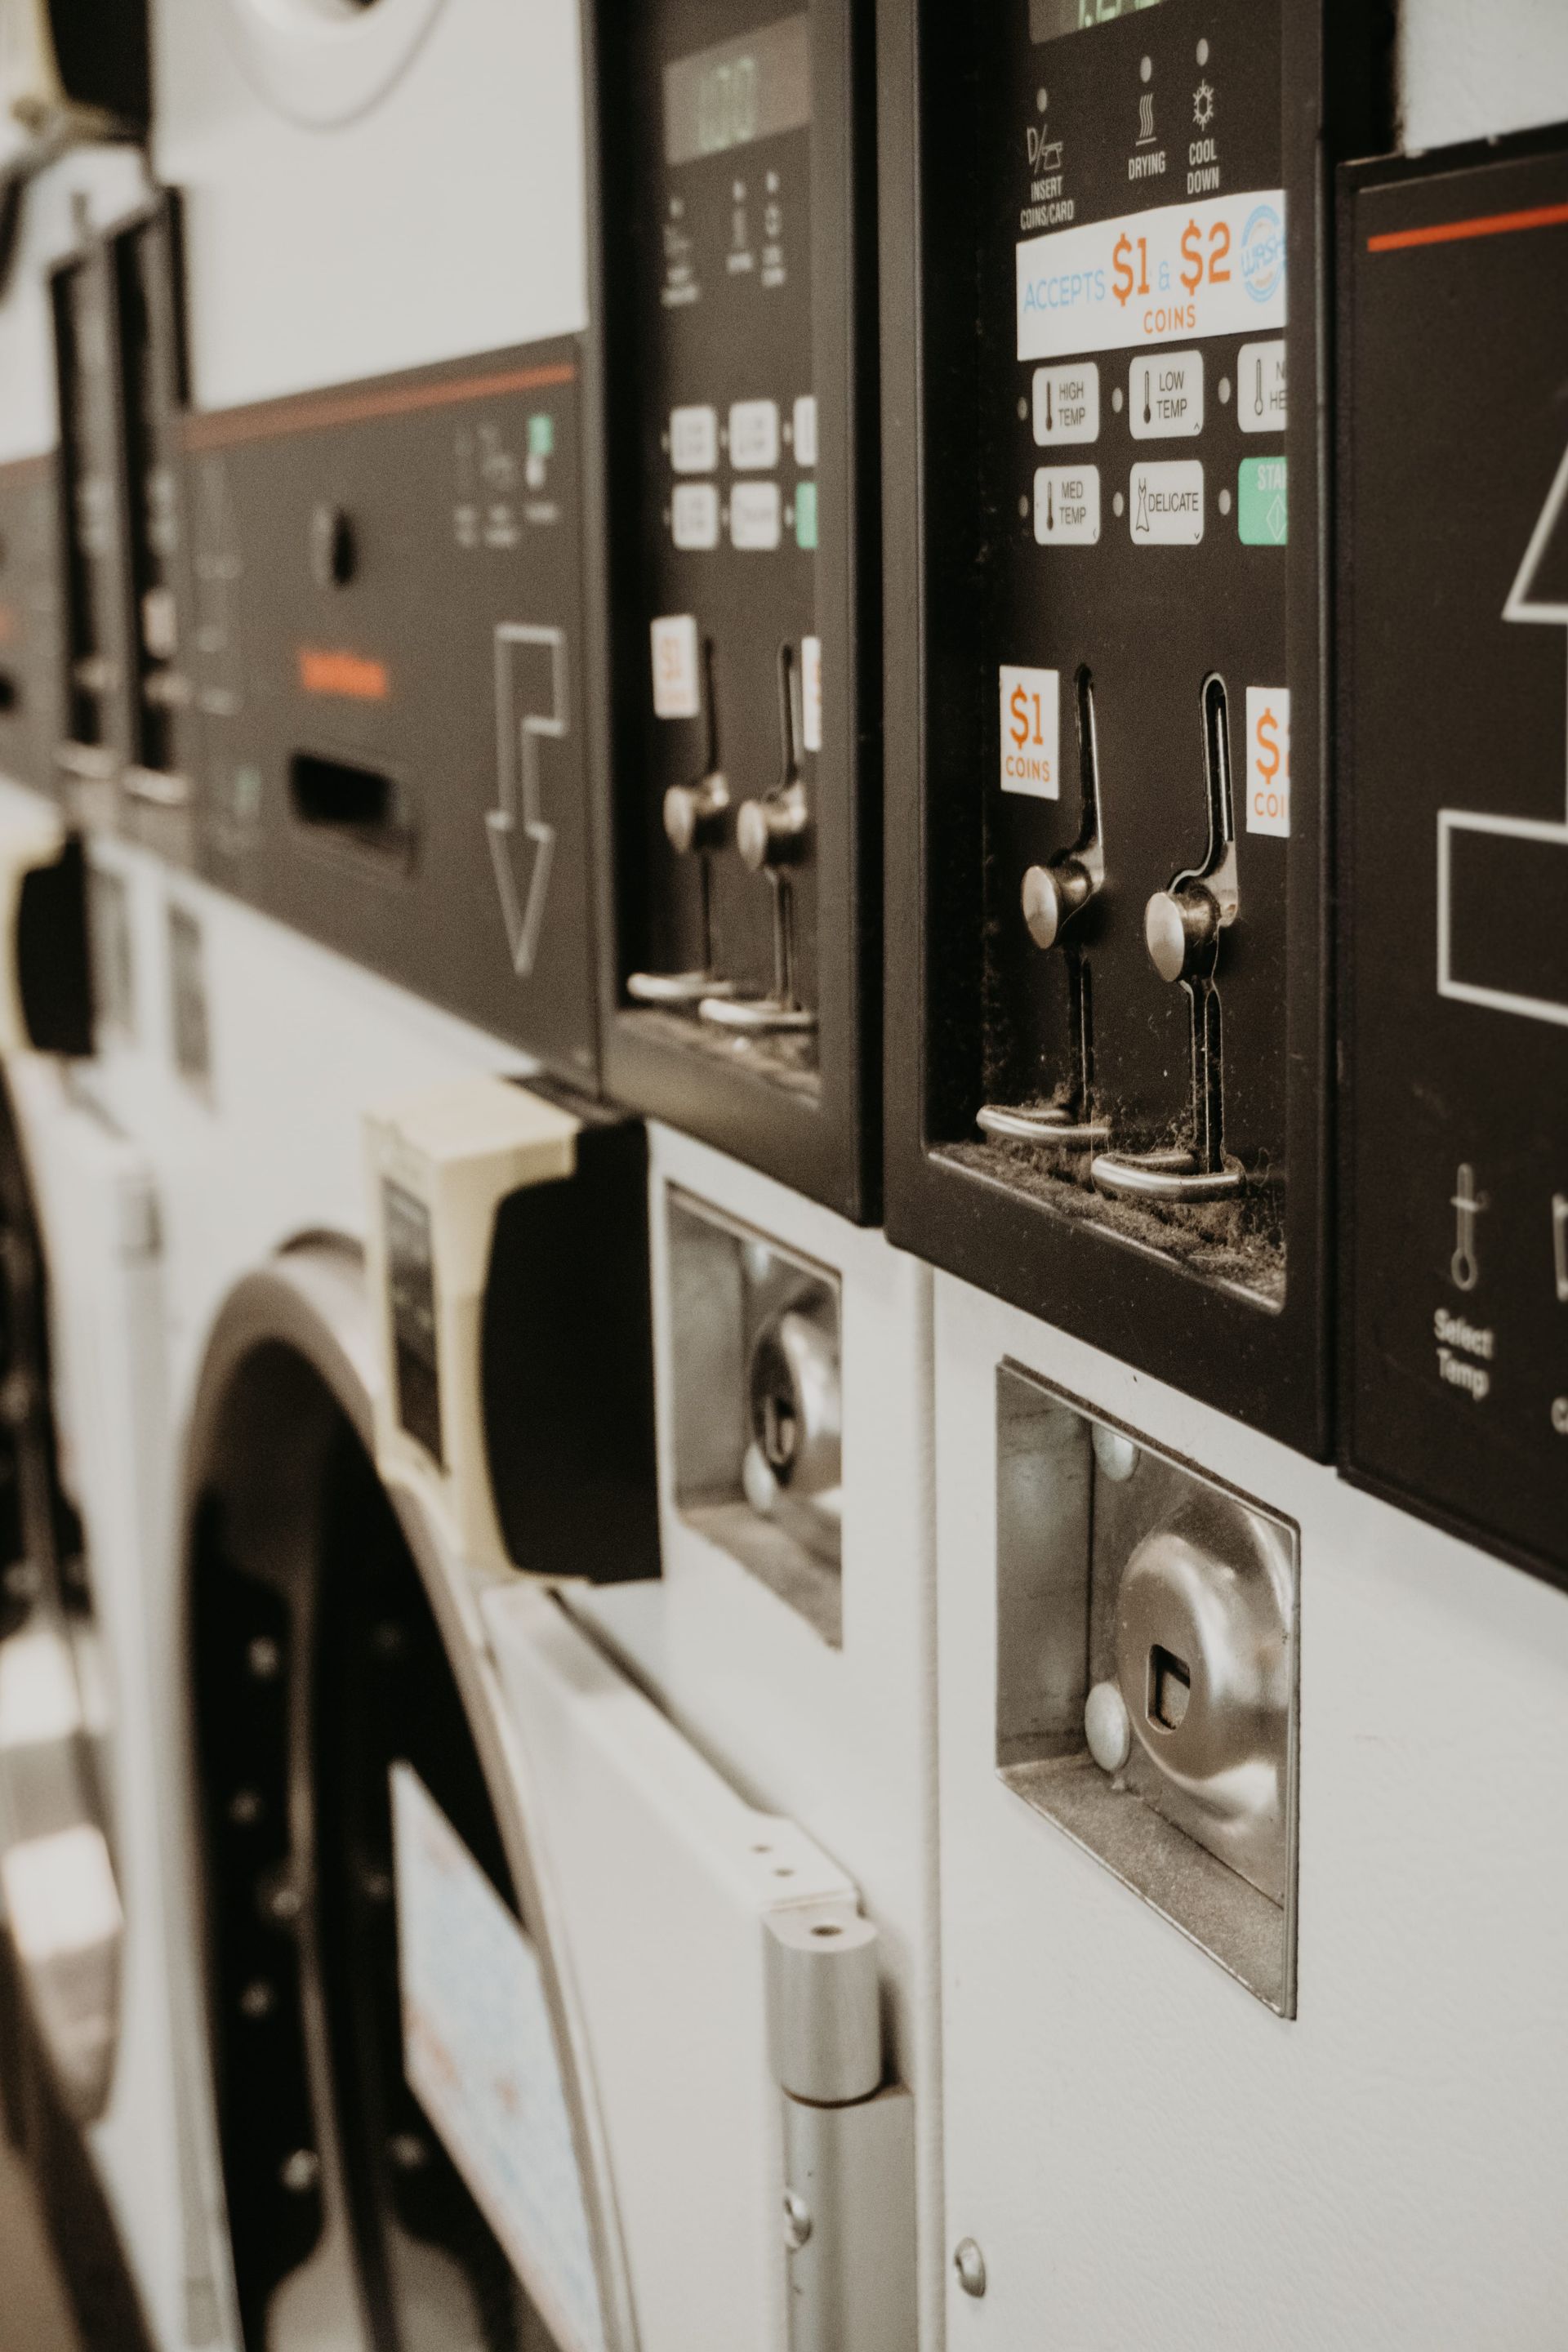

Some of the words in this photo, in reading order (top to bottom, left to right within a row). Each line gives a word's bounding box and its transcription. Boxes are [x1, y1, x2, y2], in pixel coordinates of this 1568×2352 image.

[1128, 150, 1166, 180] DRYING
[1189, 138, 1218, 166] COOL
[1031, 176, 1062, 203] INSERT
[1187, 166, 1220, 194] DOWN
[1020, 199, 1075, 230] COINS/CARD
[1023, 270, 1106, 314] ACCEPTS
[1111, 233, 1150, 306] $1
[1158, 261, 1170, 292] &
[1180, 219, 1231, 296] $2
[1143, 305, 1196, 334] COINS
[1058, 381, 1084, 401] HIGH
[1158, 370, 1185, 392] LOW
[1058, 406, 1086, 426] TEMP
[1156, 397, 1188, 419] TEMP
[1061, 480, 1084, 501] MED
[1148, 492, 1200, 513] DELICATE
[1059, 506, 1087, 525] TEMP
[1009, 684, 1044, 750] $1
[1005, 756, 1050, 783] COINS
[1435, 1308, 1493, 1361] Select
[1437, 1348, 1490, 1402] Temp
